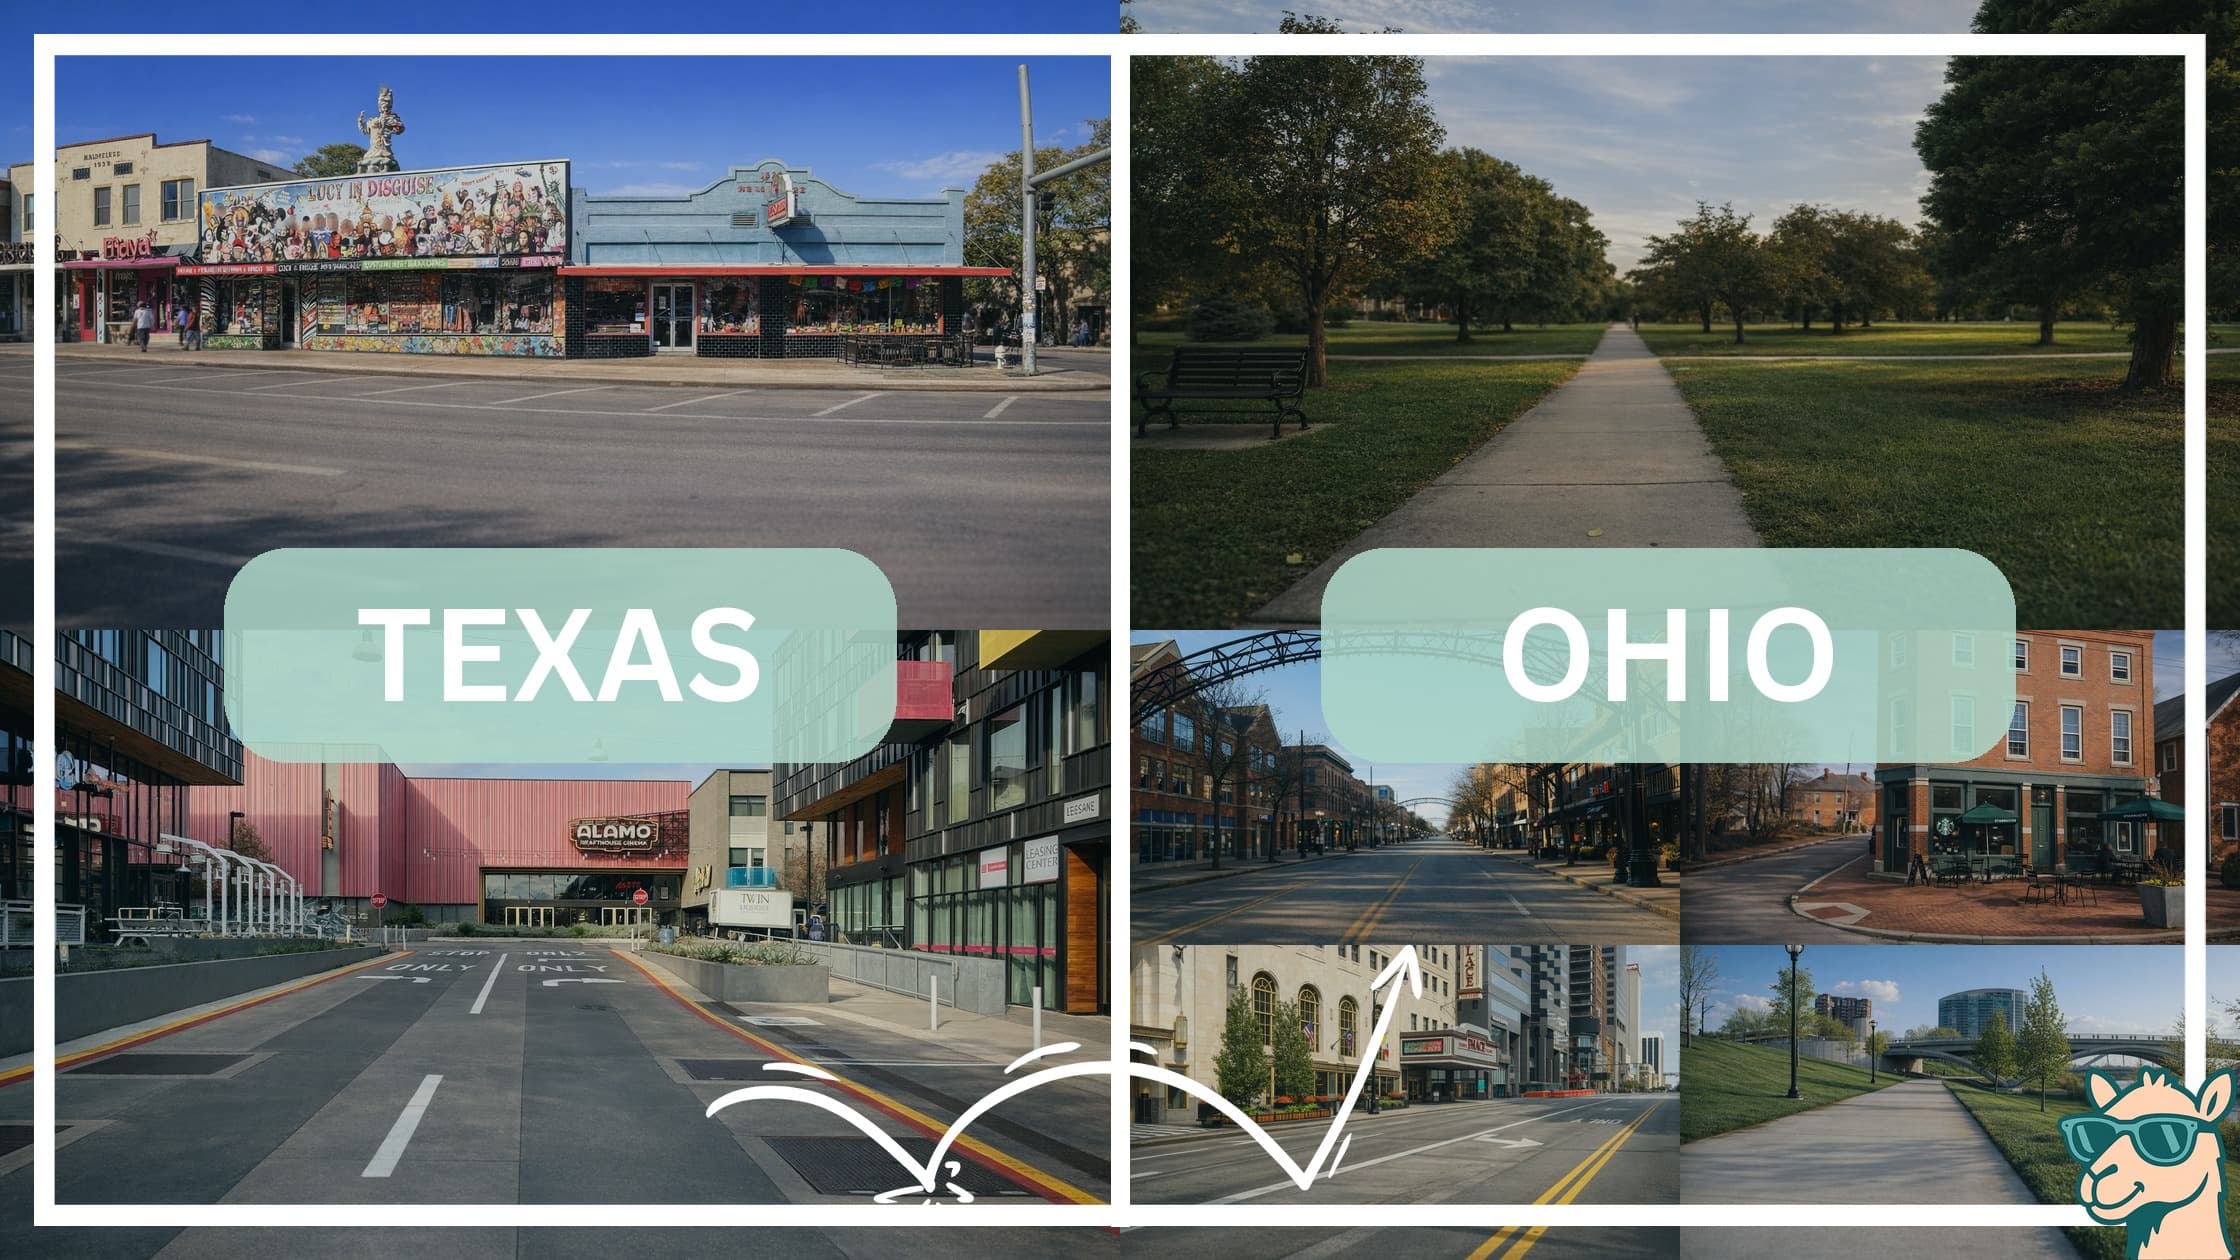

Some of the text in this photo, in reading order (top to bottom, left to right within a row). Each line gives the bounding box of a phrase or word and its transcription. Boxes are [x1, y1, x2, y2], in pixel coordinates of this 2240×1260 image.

[307, 183, 344, 201] LUCY
[349, 181, 363, 200] IN
[367, 176, 435, 198] DISGUISE
[576, 824, 651, 839] ALAMO
[1026, 844, 1058, 860] LEASING
[1026, 857, 1058, 870] CENTER
[740, 893, 770, 905] TWIN
[386, 964, 478, 972] ONLY
[517, 964, 609, 973] ONLY
